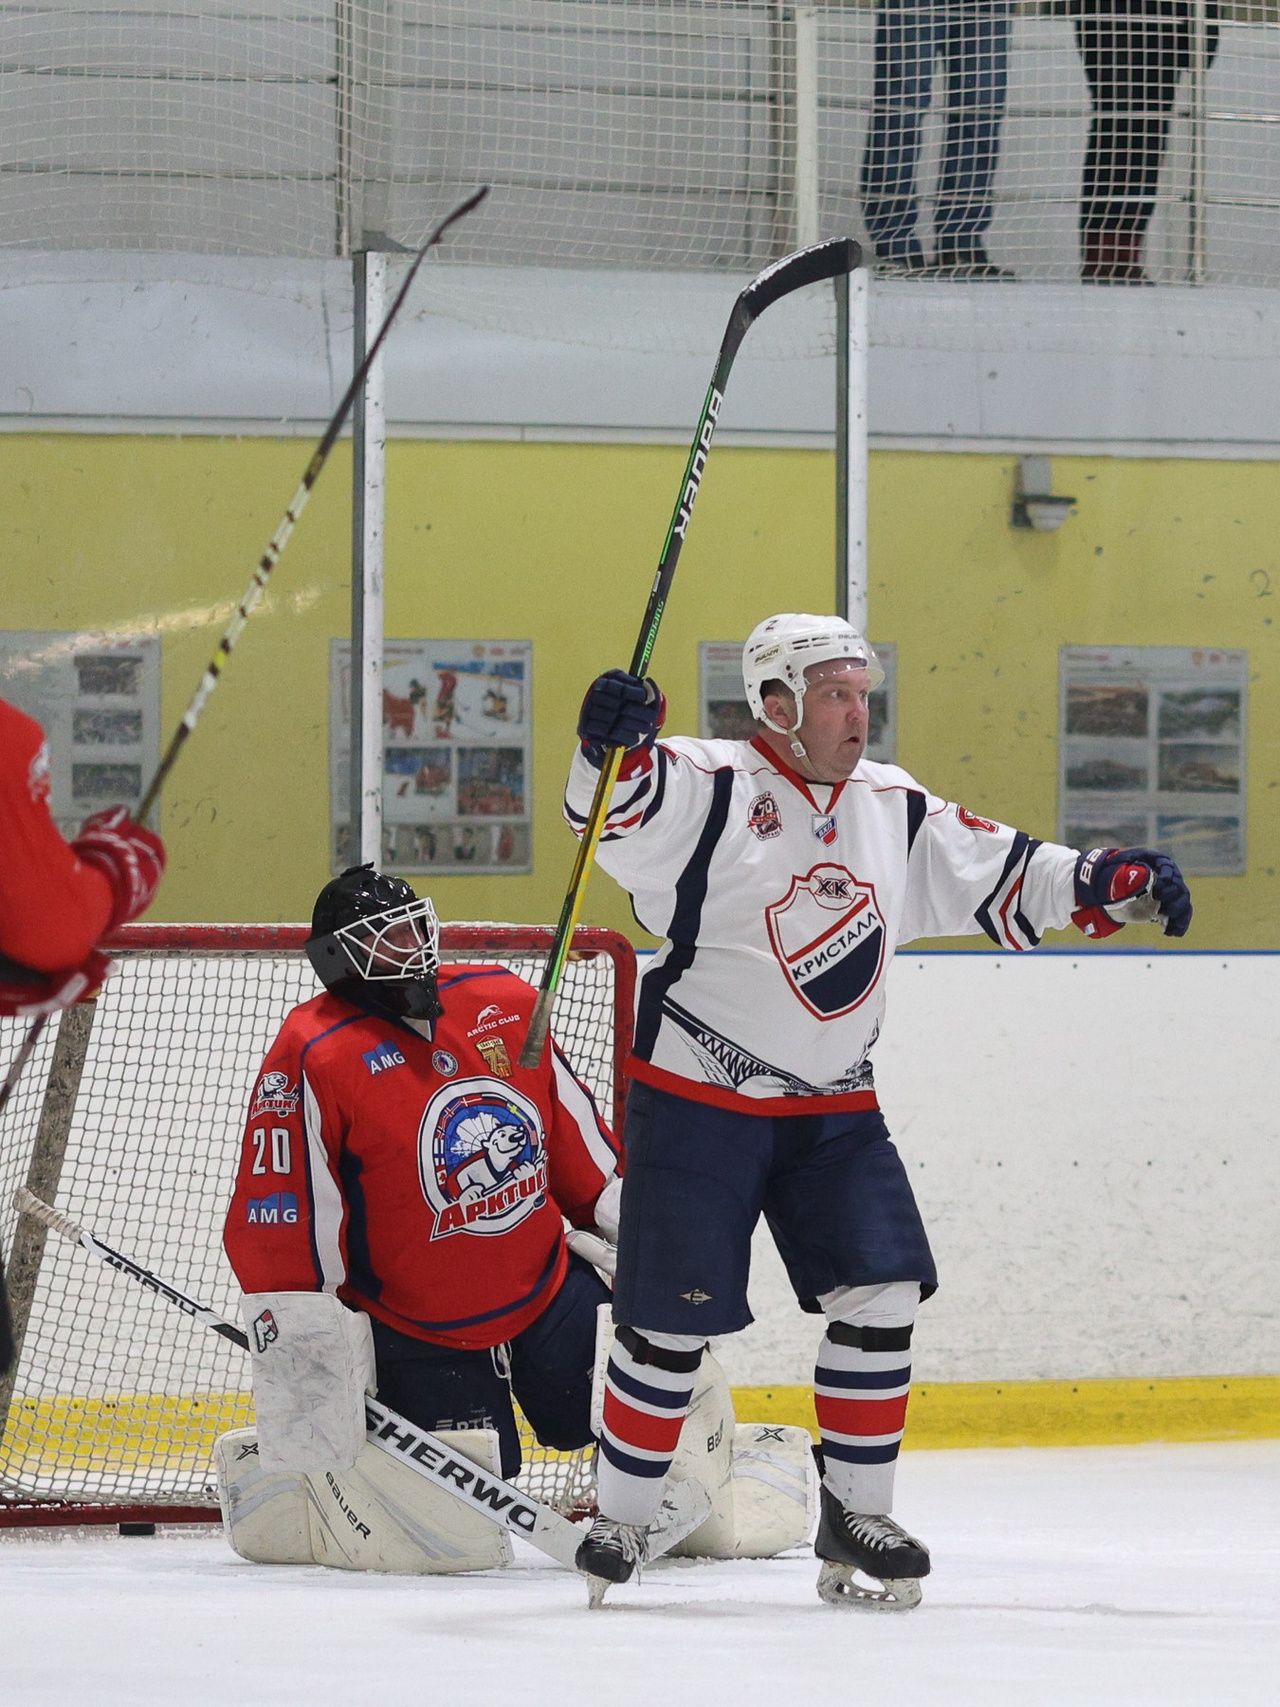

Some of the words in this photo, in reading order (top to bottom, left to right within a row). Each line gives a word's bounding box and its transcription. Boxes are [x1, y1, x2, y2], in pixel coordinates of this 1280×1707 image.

[792, 912, 878, 981] КРИСТАЛЛ
[467, 1020, 498, 1037] ARCTIC
[498, 1014, 520, 1026] CLUB
[371, 1051, 406, 1075] AMG
[252, 1127, 291, 1176] 20
[248, 1208, 297, 1224] AMG
[366, 1408, 537, 1533] SHERWO
